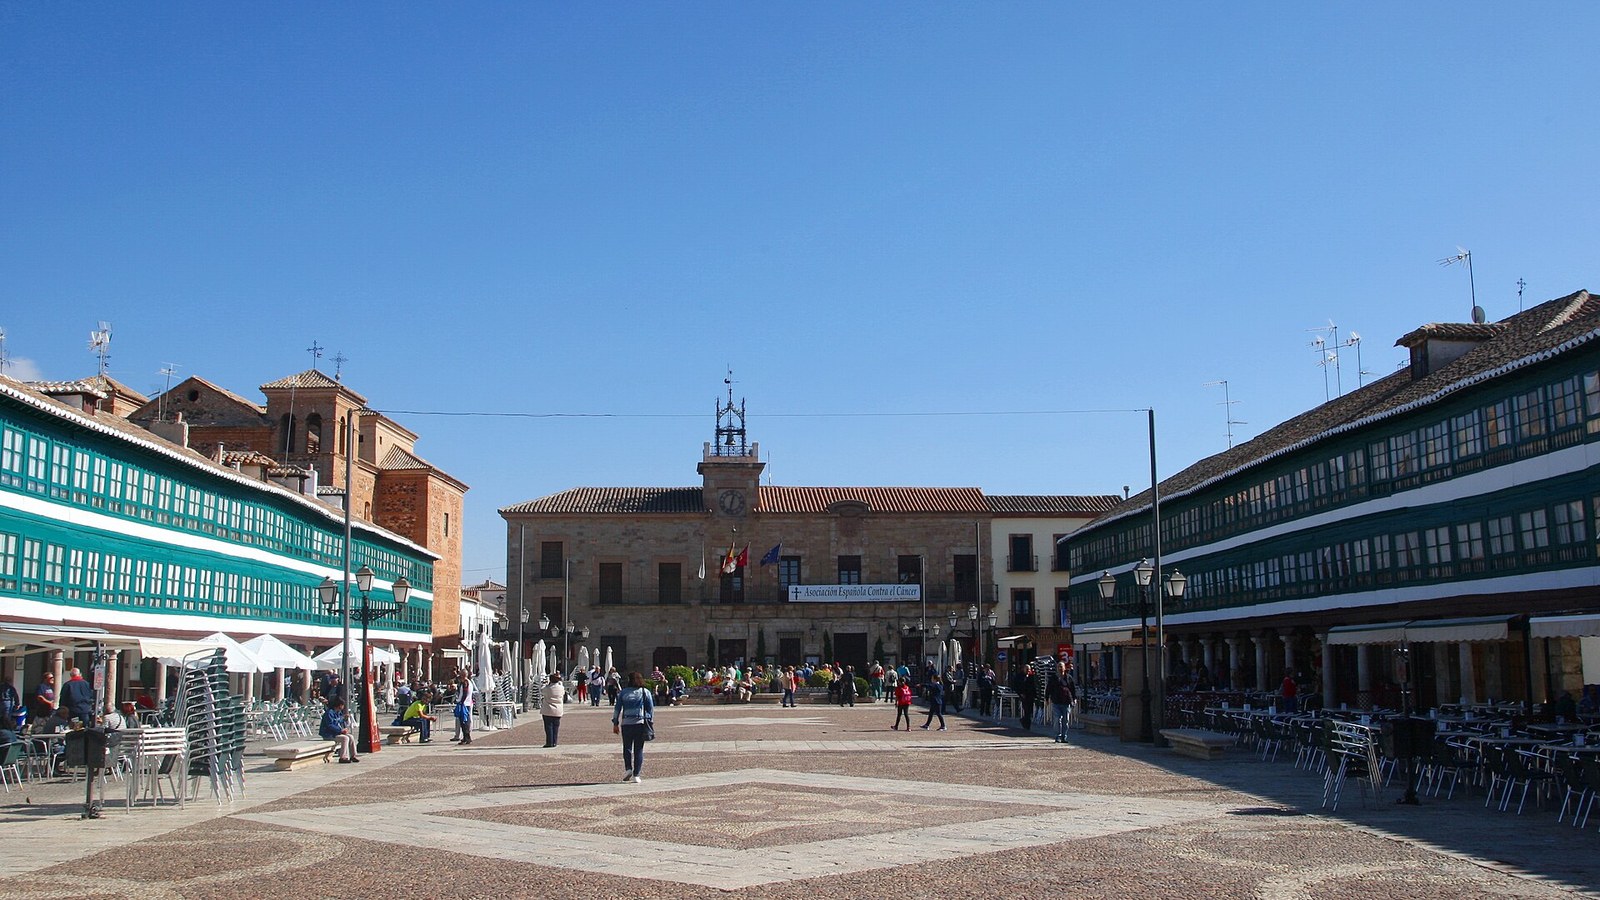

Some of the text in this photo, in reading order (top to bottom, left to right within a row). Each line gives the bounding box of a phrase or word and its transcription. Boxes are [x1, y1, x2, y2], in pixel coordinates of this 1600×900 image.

[804, 586, 917, 599] Asociación Española Contra el Cáncer
